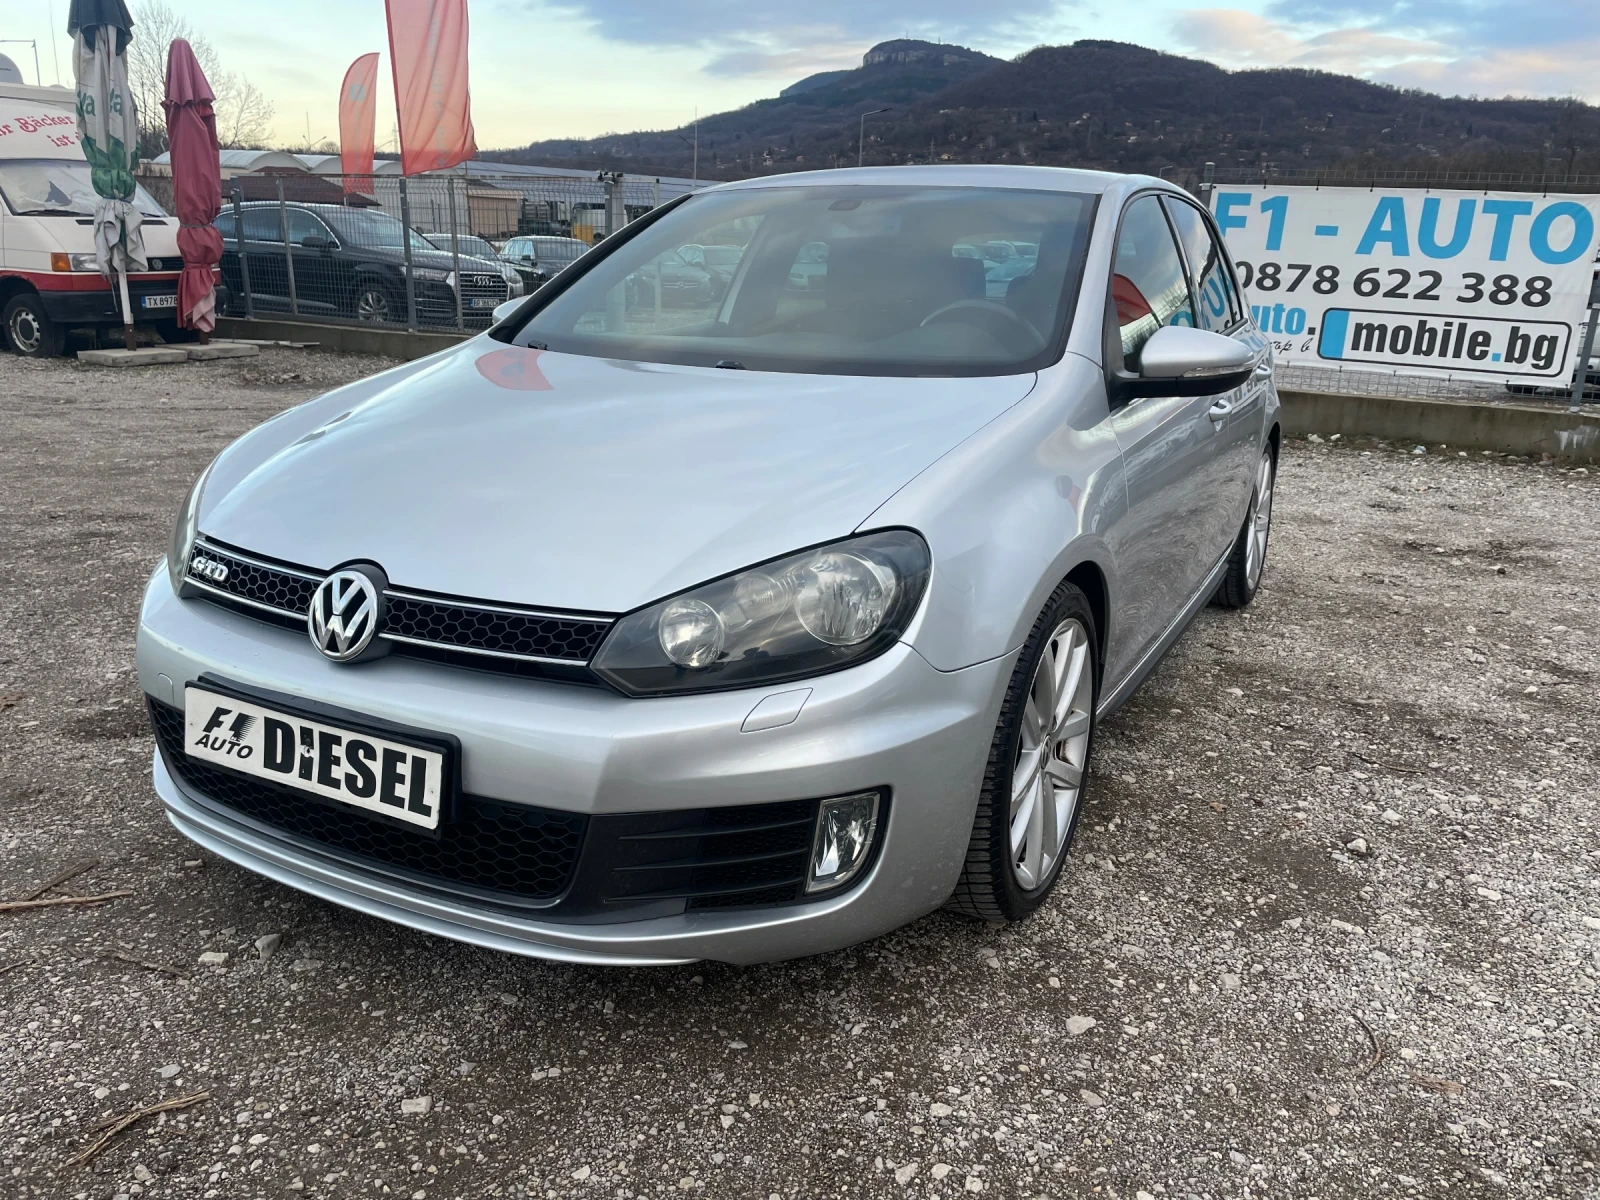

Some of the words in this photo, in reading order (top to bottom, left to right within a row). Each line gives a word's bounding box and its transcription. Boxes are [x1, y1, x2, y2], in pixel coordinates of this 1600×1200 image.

[14, 114, 75, 133] Bäcker
[46, 134, 75, 147] ist
[1214, 192, 1289, 251] F1
[1355, 196, 1594, 265] AUTO
[1236, 260, 1340, 295] 0878
[1352, 267, 1443, 301] 622
[1456, 272, 1553, 307] 388
[147, 297, 158, 306] TX
[1351, 319, 1559, 371] mobile.bg
[192, 556, 229, 582] GTD
[194, 734, 254, 760] AUTO
[263, 716, 433, 818] DIESEL
